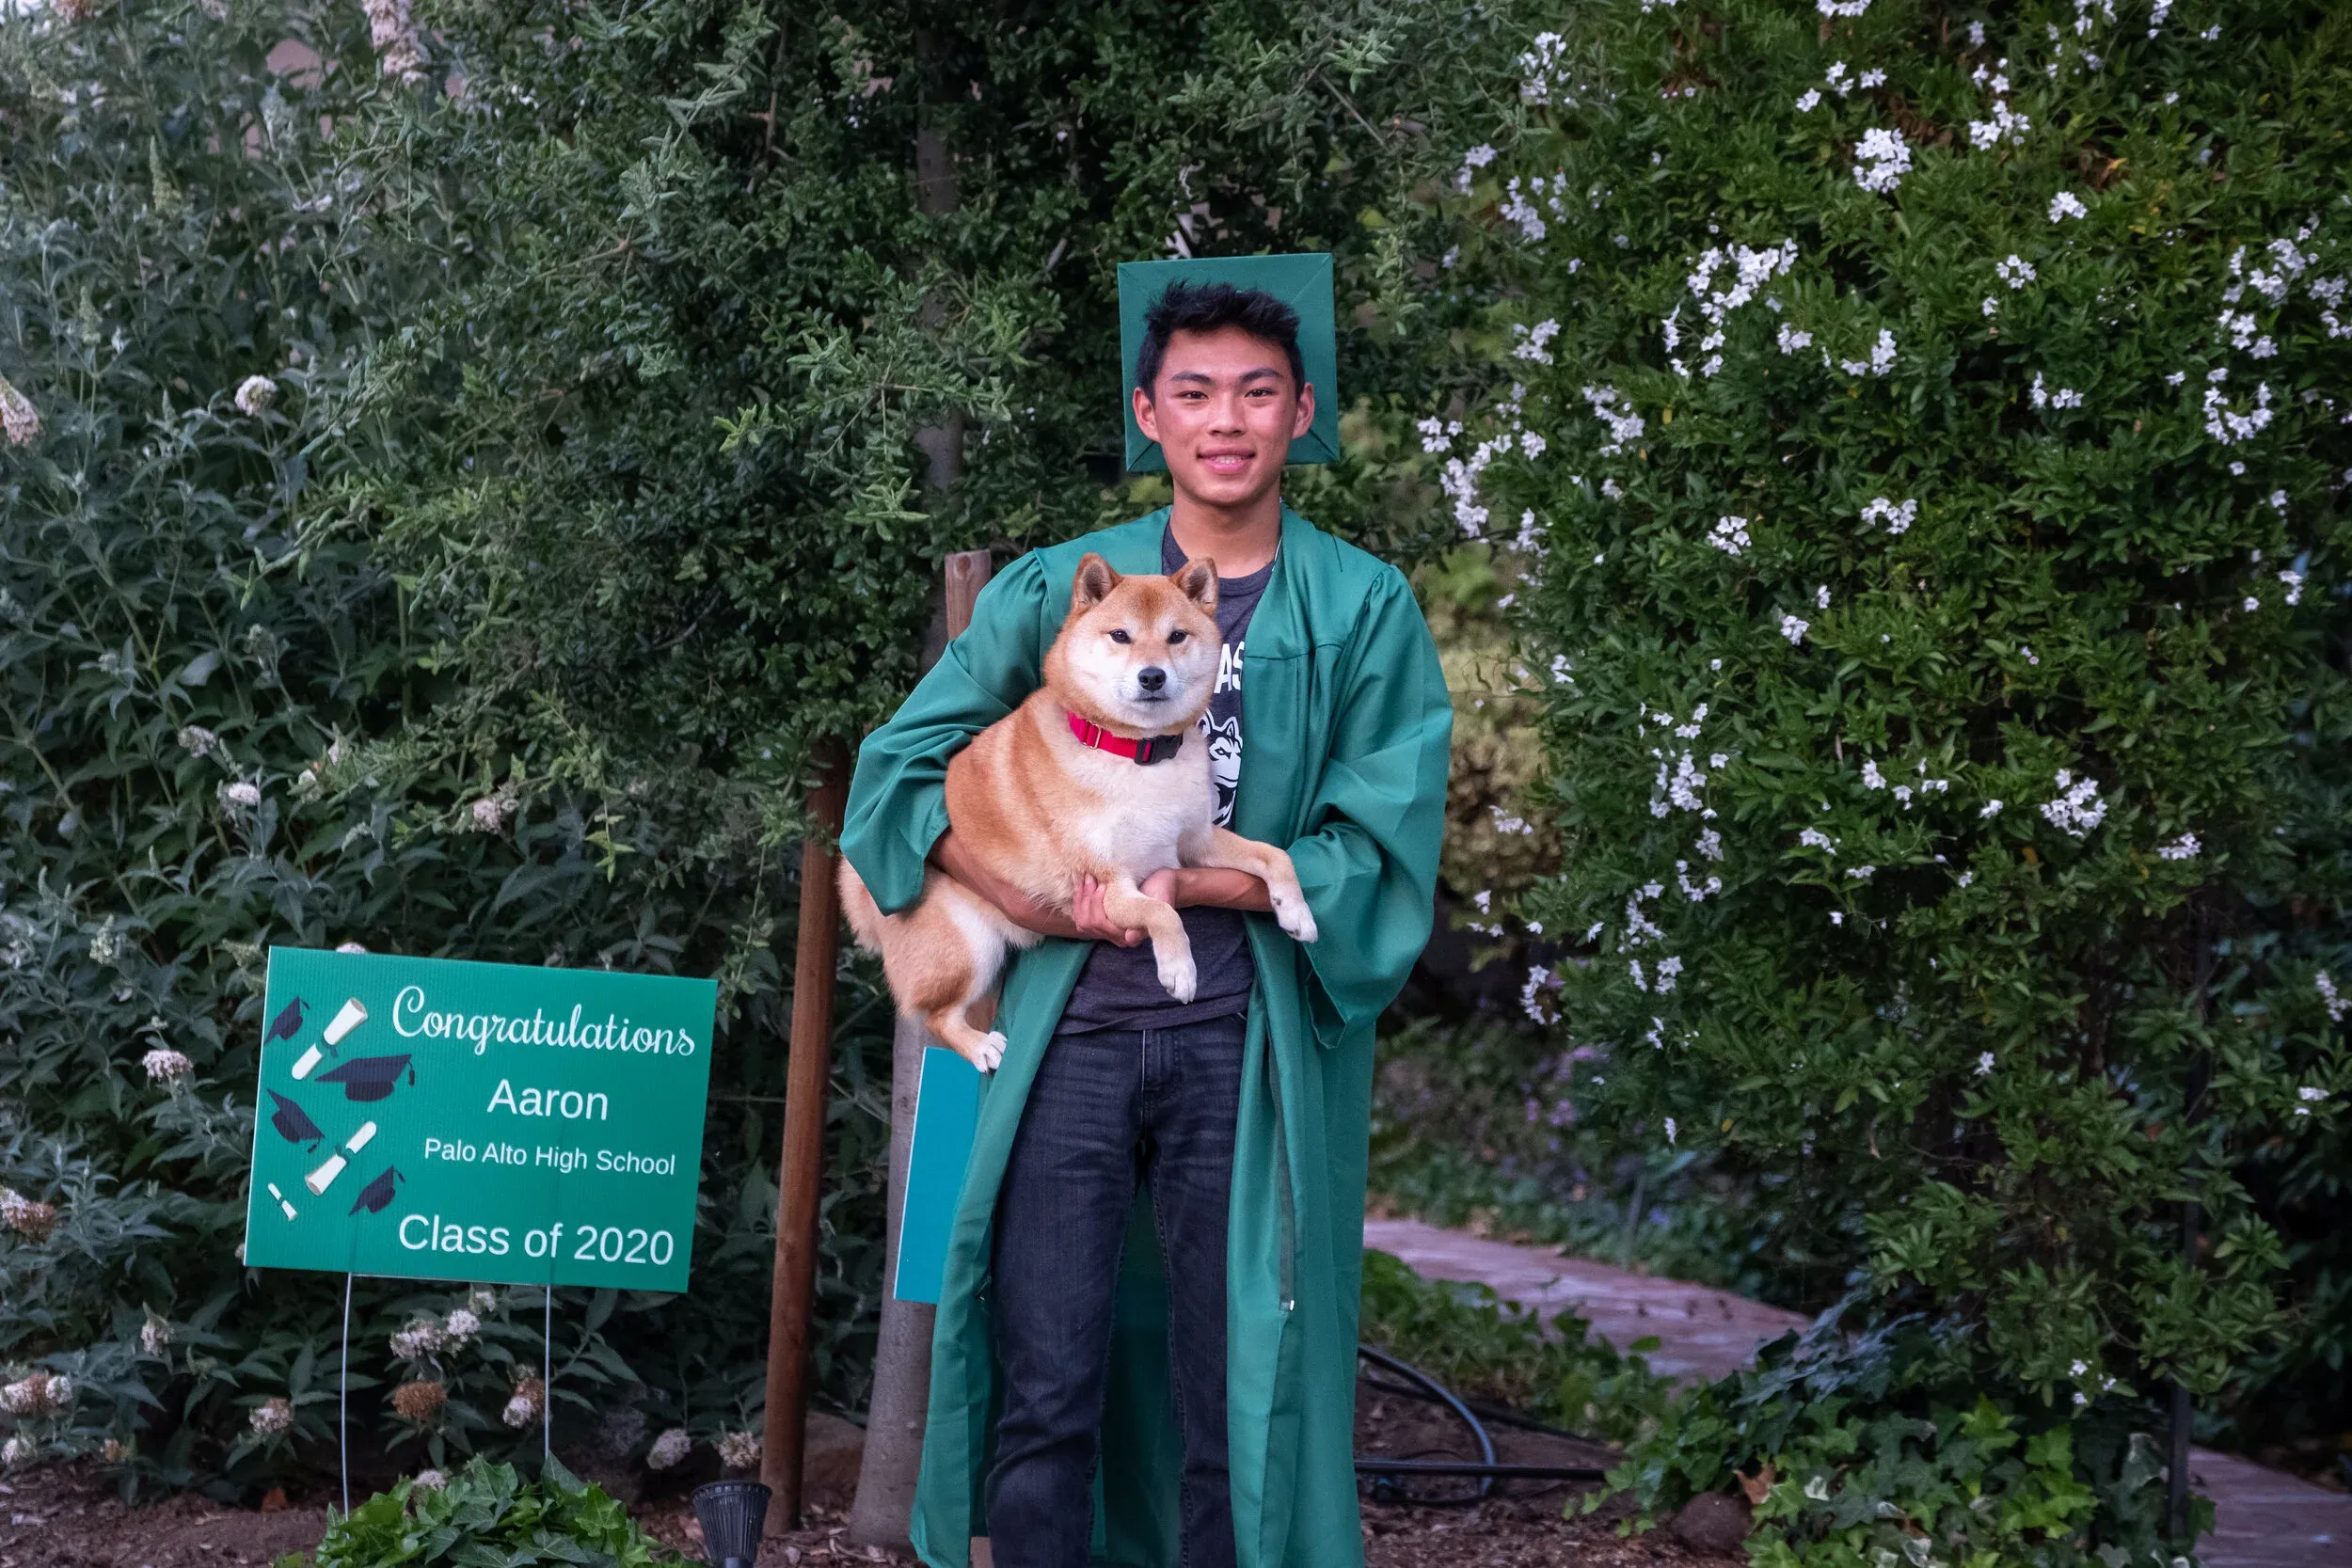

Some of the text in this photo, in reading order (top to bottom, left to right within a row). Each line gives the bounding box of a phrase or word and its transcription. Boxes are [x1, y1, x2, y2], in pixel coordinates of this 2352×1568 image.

[392, 986, 695, 1056] Congratulations
[486, 1079, 608, 1120] Aaron
[424, 1138, 676, 1176] Palo Alto High School
[399, 1214, 675, 1266] Class of 2020
